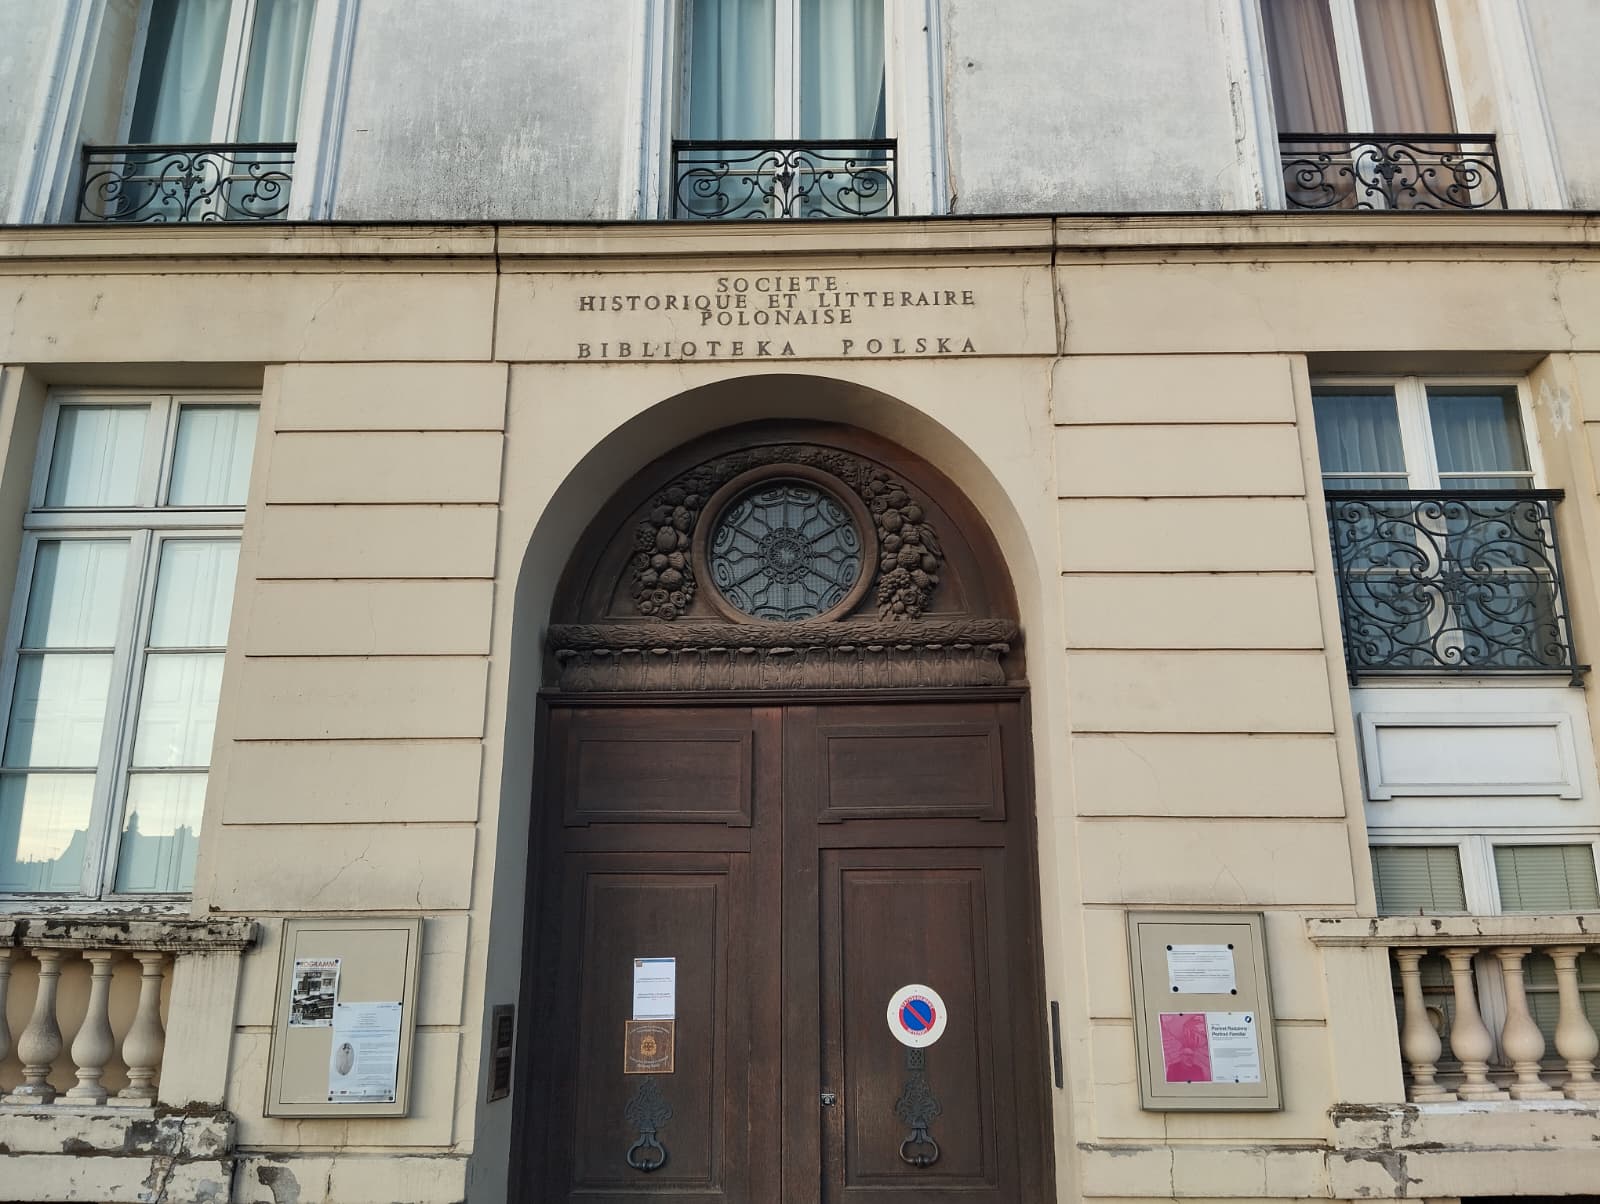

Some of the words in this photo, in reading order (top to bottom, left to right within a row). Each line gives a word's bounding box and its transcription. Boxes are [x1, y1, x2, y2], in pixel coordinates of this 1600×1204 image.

[717, 276, 838, 293] SOCIETE
[579, 294, 747, 312] HISTORIQUE
[768, 293, 797, 309] ET
[818, 290, 975, 308] LITTERAIRE
[700, 309, 852, 326] POLONAISE
[577, 341, 796, 359] BIBLIOTEKA
[842, 337, 976, 355] POLSKA
